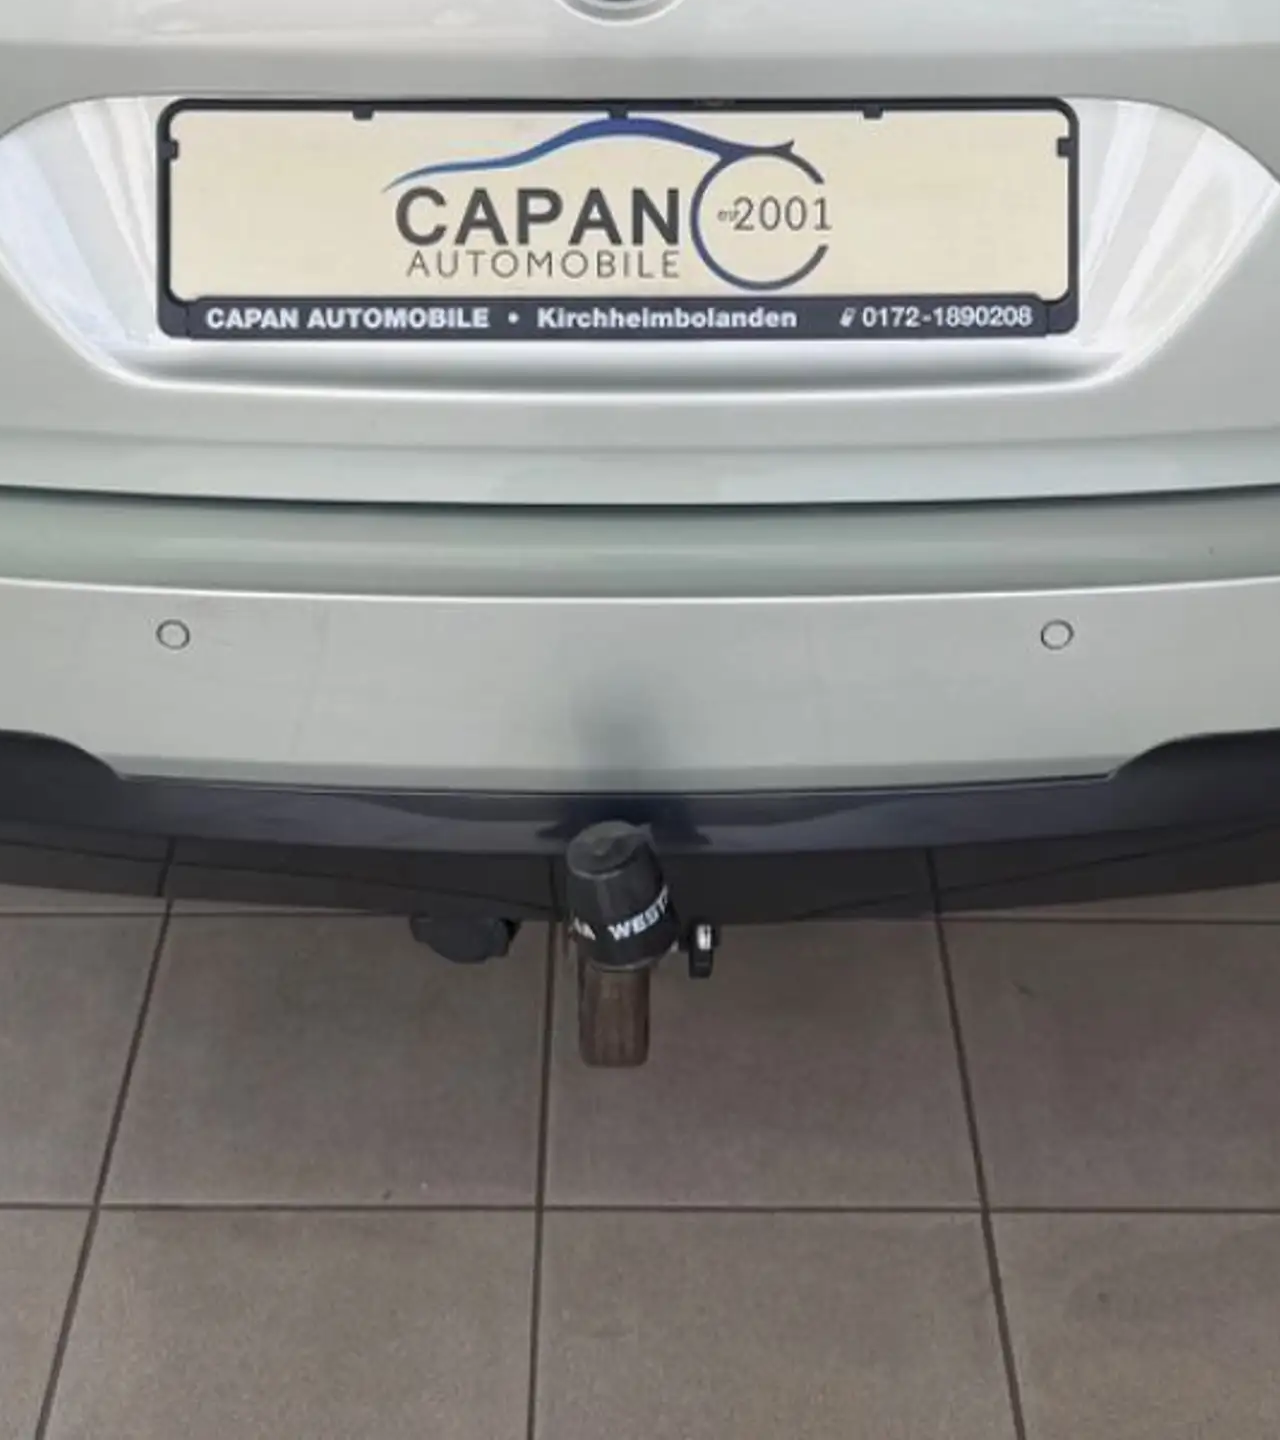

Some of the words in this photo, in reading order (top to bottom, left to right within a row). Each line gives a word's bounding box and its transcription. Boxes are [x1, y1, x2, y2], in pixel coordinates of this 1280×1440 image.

[395, 186, 680, 247] CAPAN
[733, 195, 833, 232] 2001
[406, 250, 680, 279] AUTOMOBILE
[206, 307, 299, 330] CAPAN
[306, 307, 490, 330] AUTOMOBILE
[536, 306, 798, 329] Kirchheimbolanden
[862, 305, 1032, 328] 0172-1890208
